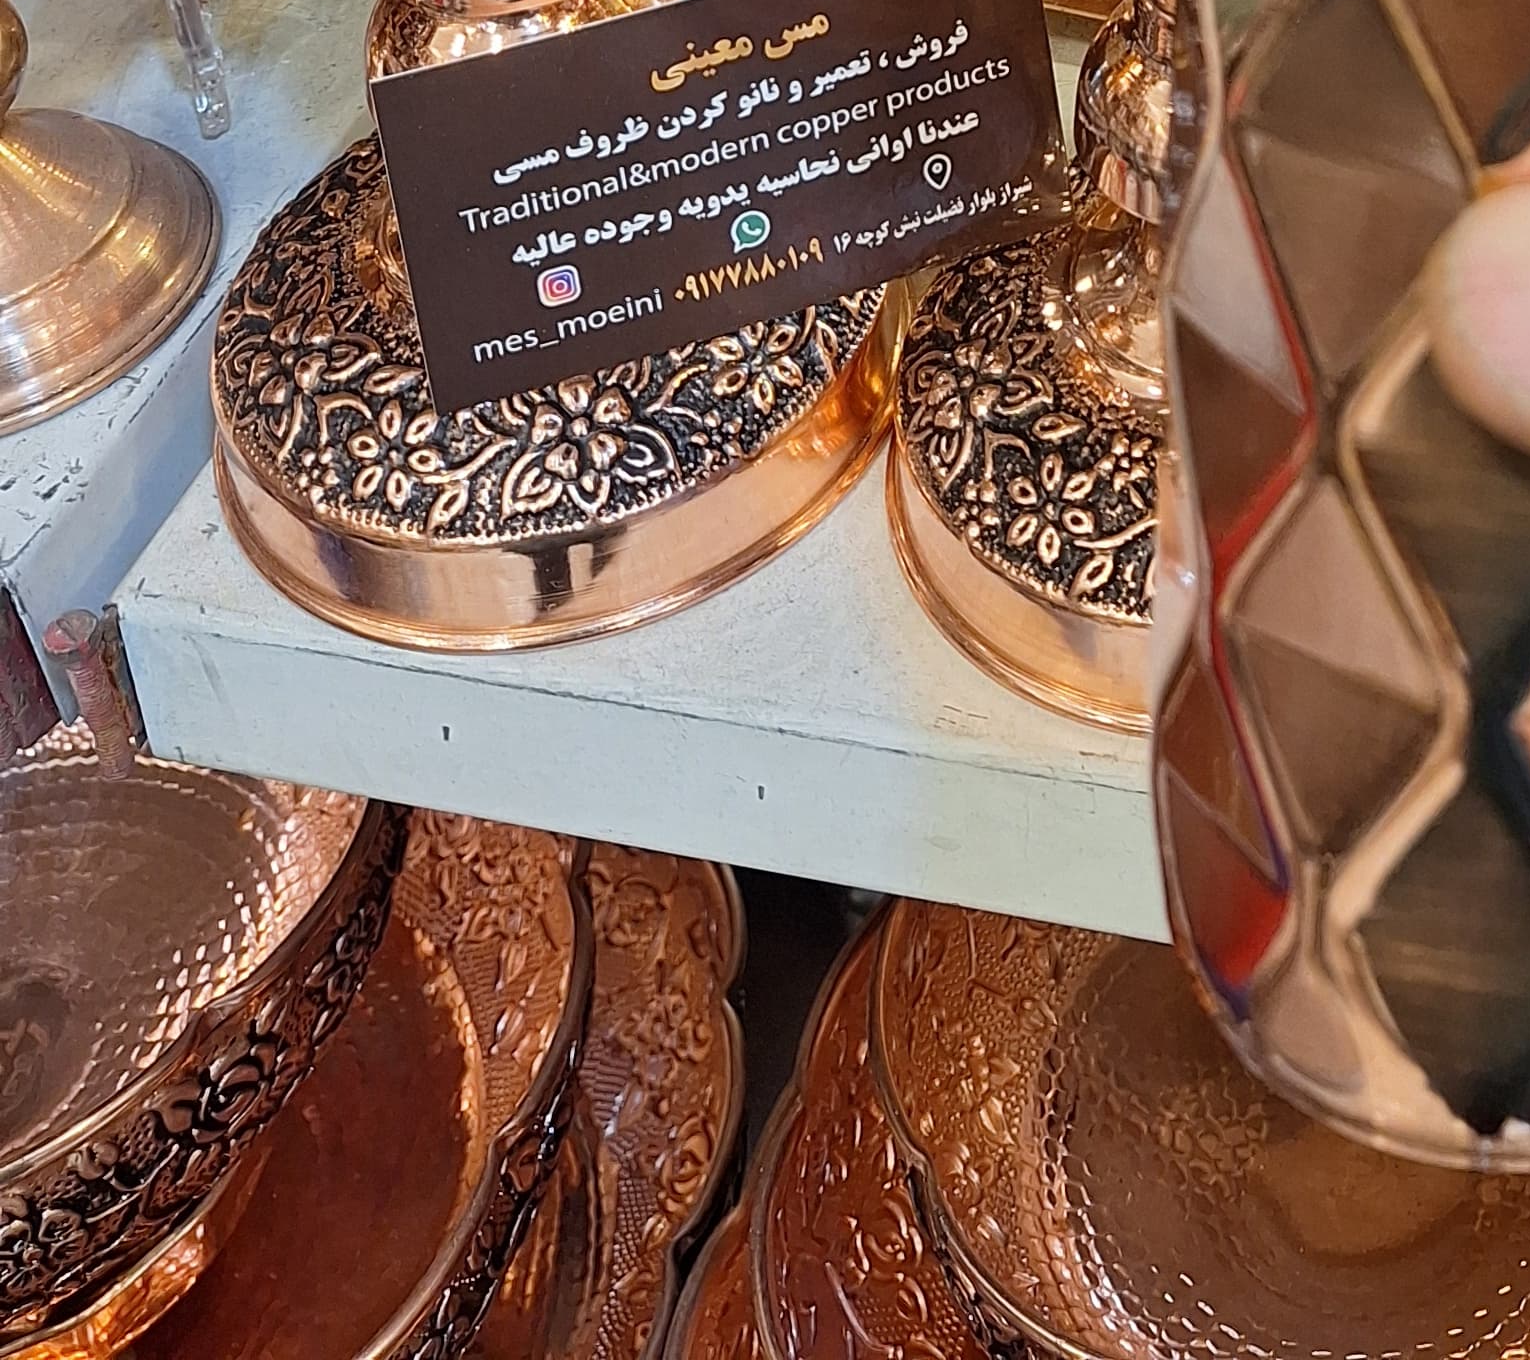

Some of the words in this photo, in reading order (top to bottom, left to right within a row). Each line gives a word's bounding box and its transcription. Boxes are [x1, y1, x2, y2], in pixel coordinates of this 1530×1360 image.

[764, 14, 830, 59] مس
[895, 19, 969, 69] فروش
[651, 36, 754, 92] معینی
[809, 50, 871, 97] تعمیر
[737, 77, 780, 119] نانو
[788, 80, 803, 104] و
[657, 90, 728, 139] کردن
[917, 112, 979, 144] عندنا
[458, 132, 770, 233] Traditional&modern
[776, 98, 878, 143] copper
[886, 58, 1010, 117] products
[565, 116, 649, 159] ظروف
[493, 148, 560, 185] مسی
[923, 196, 965, 225] فضیلت
[968, 187, 997, 216] بلوار
[999, 175, 1033, 206] شیراز
[833, 232, 852, 254] ۱۶
[893, 211, 921, 239] نبش
[674, 237, 824, 301] ۰۹۱۷۷۸۸۰۱۰۹
[473, 288, 663, 362] mes_moeini
